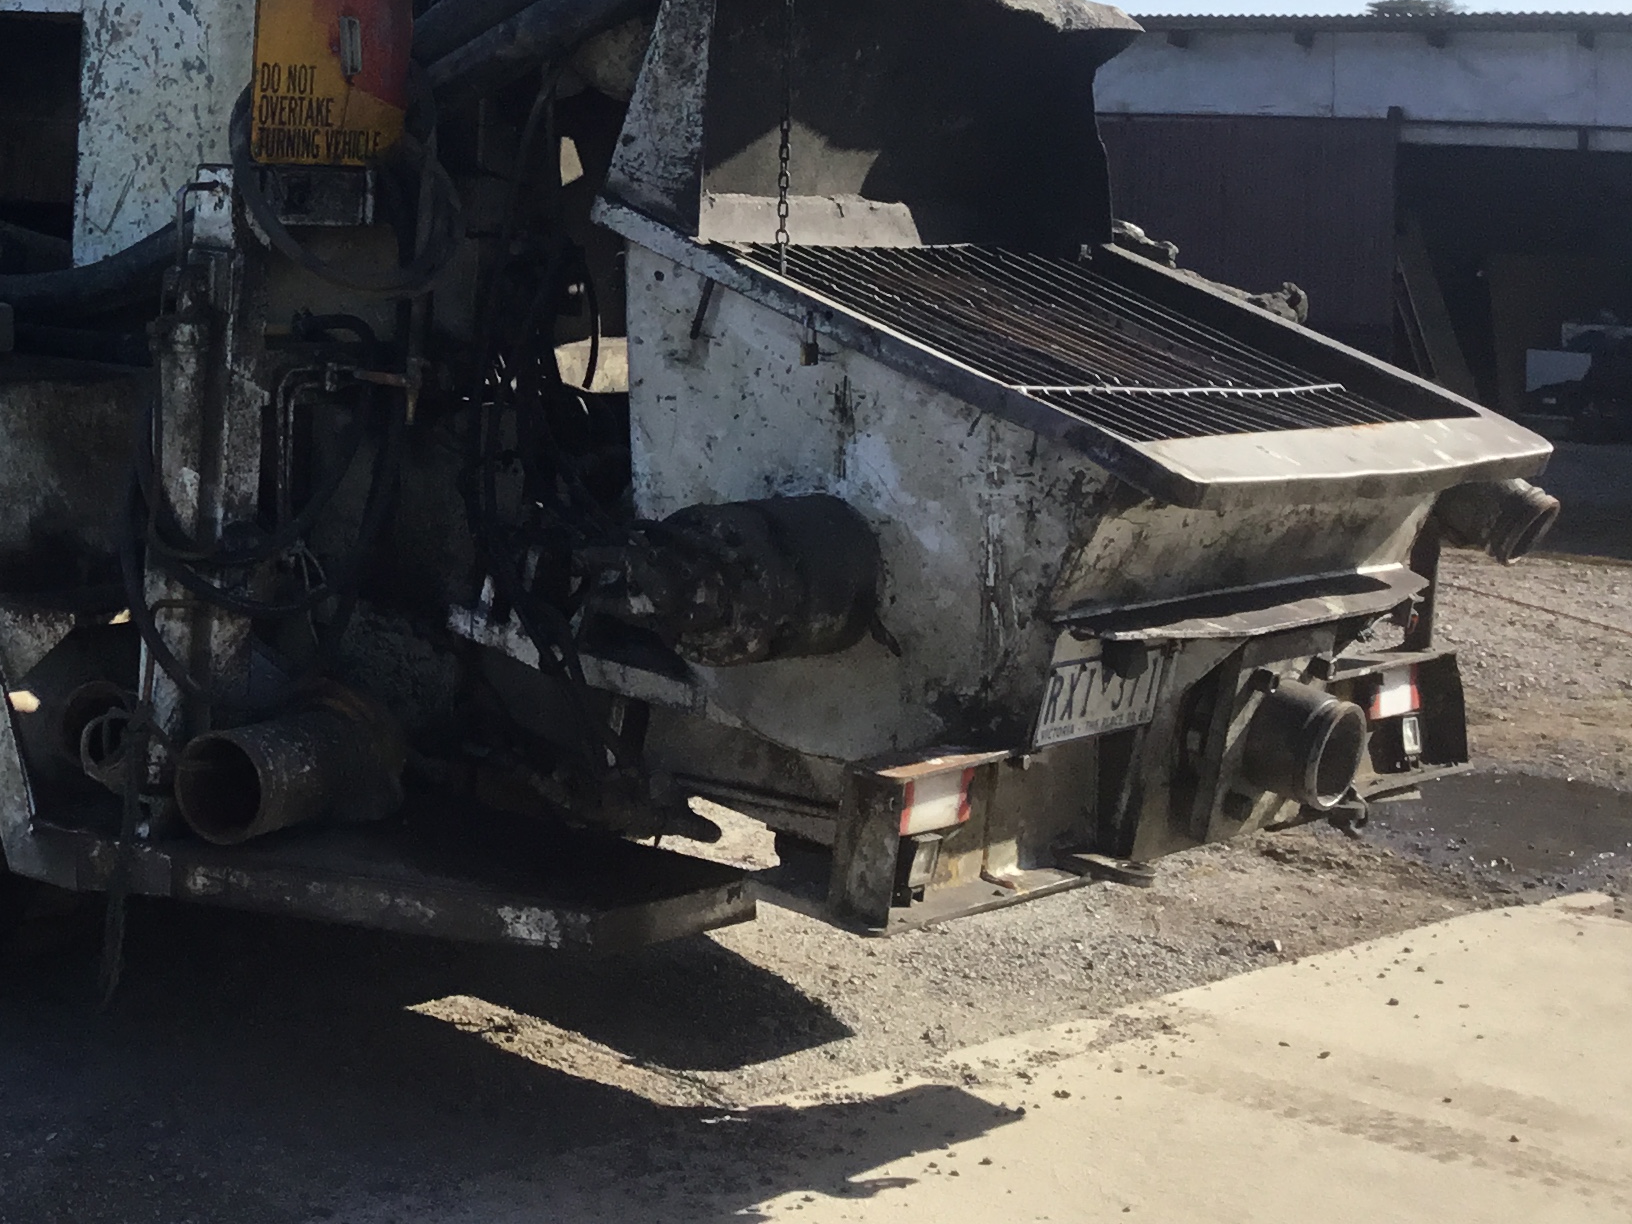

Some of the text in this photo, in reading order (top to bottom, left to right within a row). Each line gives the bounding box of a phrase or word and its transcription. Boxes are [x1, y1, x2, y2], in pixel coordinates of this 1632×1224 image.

[261, 62, 317, 94] DO NOT
[258, 95, 334, 126] OVERTAKE
[257, 127, 381, 159] TURNING VEHICLE
[1041, 724, 1074, 740] VICTORIA
